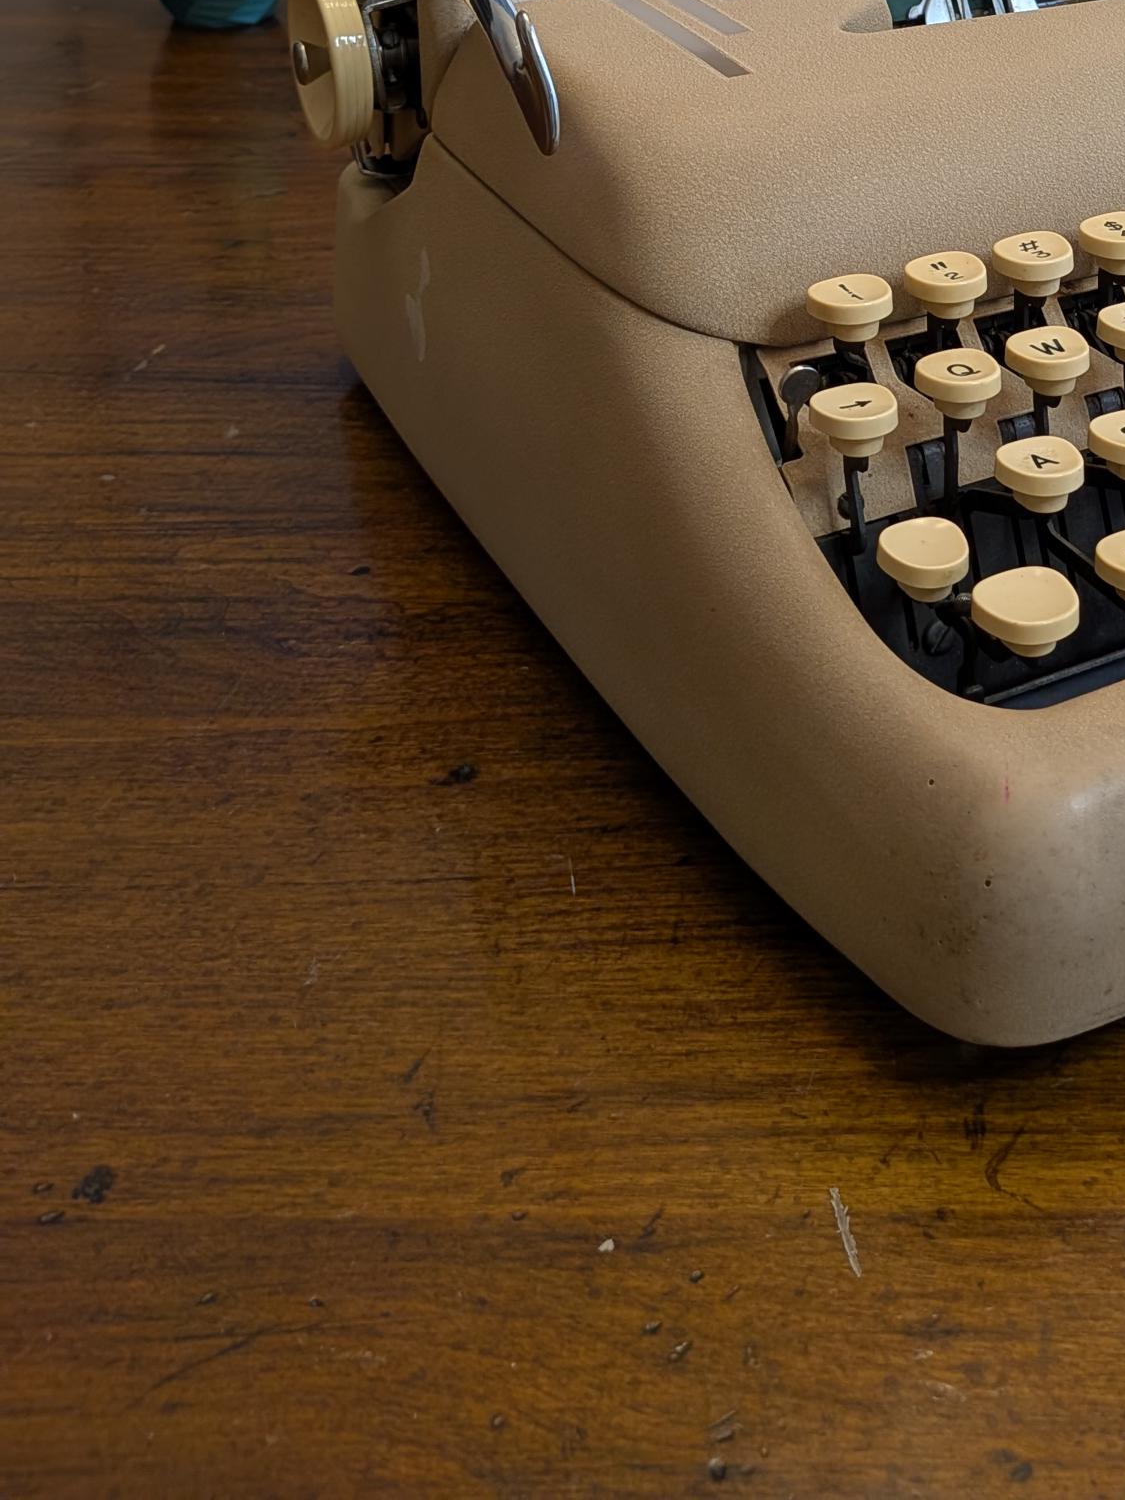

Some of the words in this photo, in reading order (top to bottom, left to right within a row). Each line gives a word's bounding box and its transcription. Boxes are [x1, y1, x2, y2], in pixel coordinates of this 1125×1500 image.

[1029, 337, 1066, 356] W
[946, 362, 981, 378] Q
[1030, 452, 1060, 469] A
